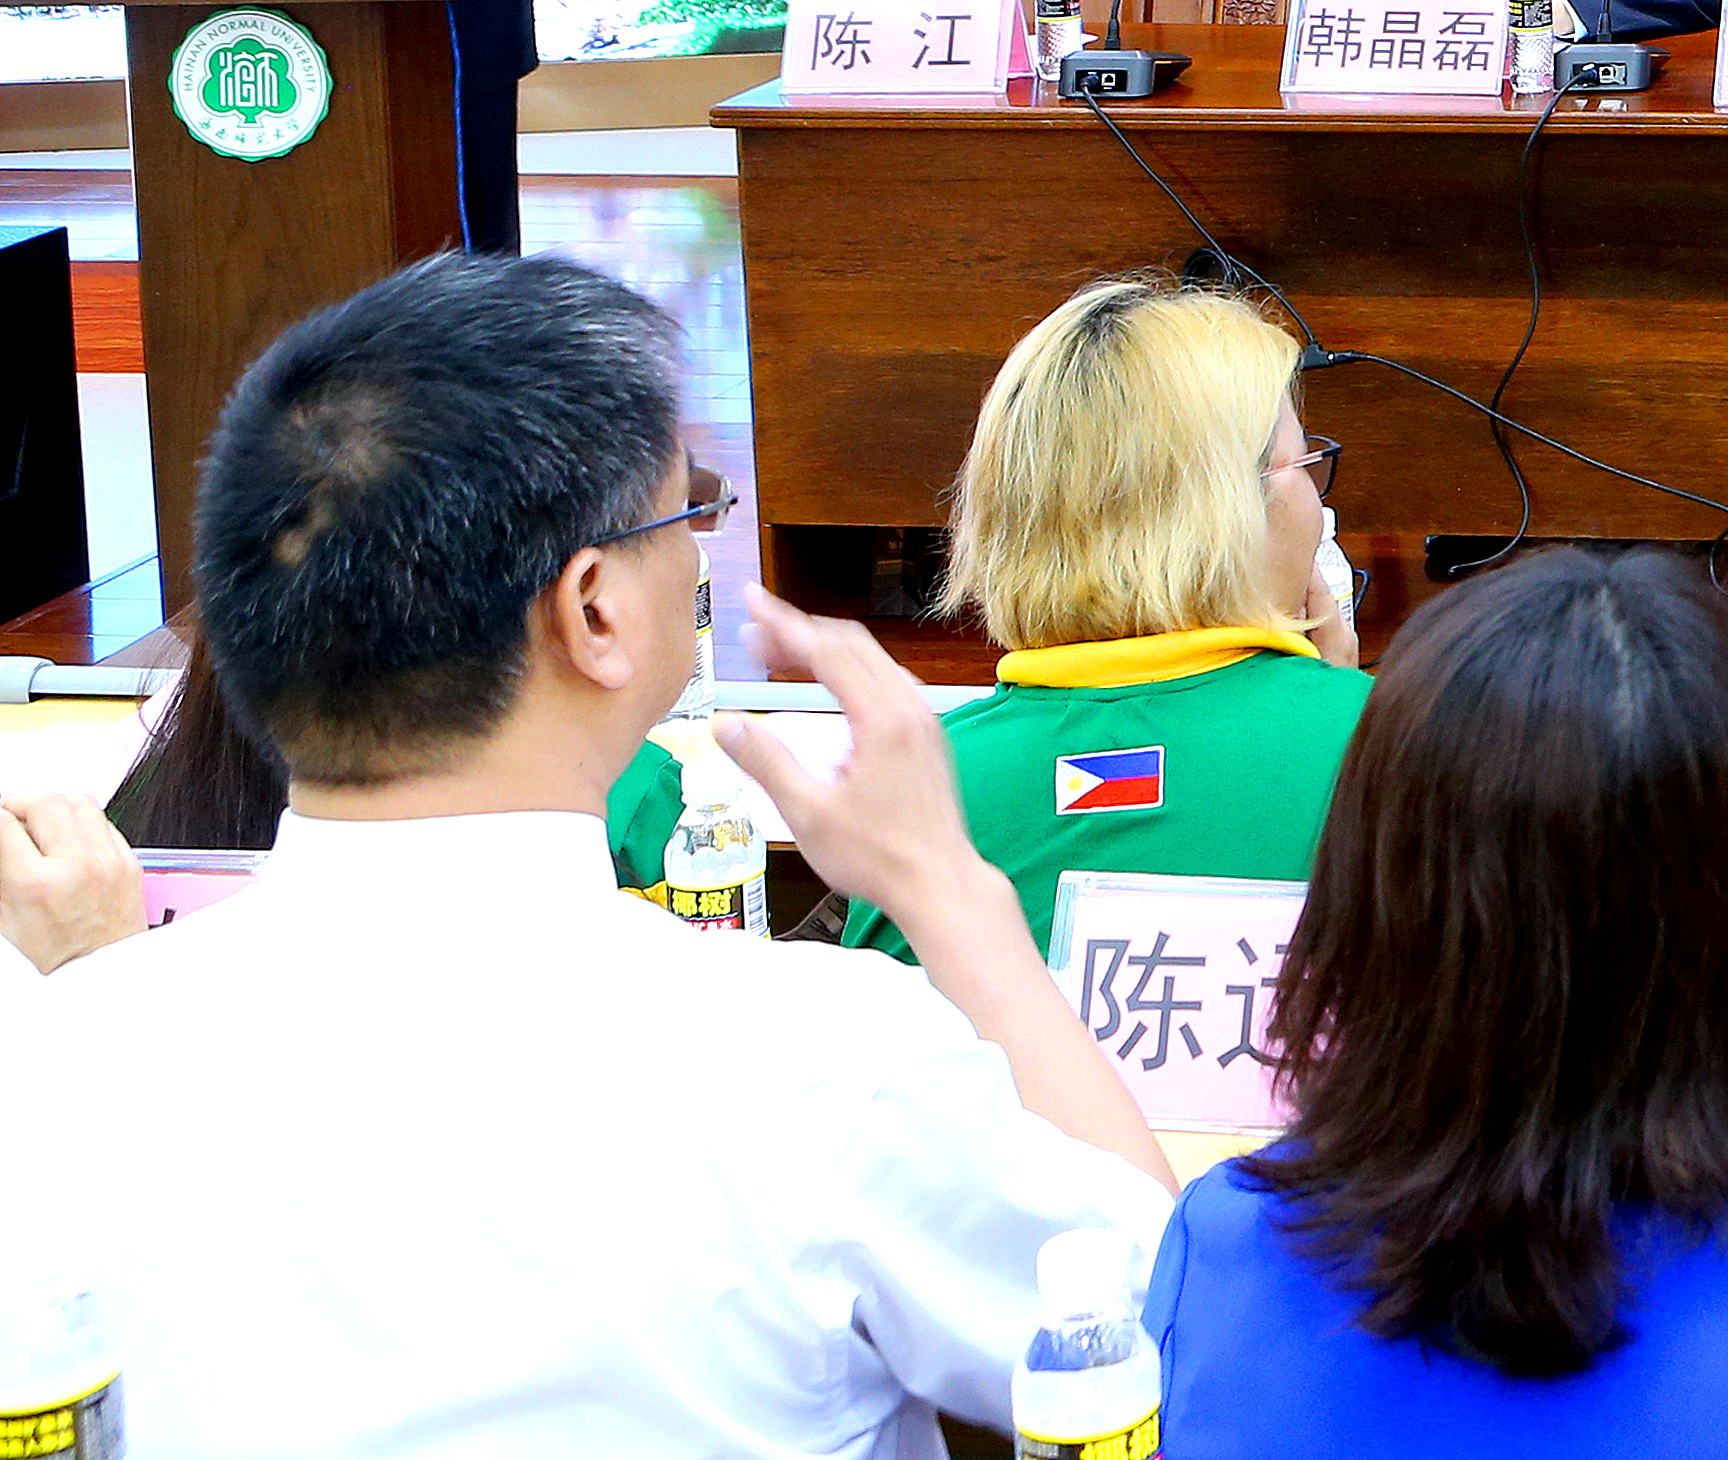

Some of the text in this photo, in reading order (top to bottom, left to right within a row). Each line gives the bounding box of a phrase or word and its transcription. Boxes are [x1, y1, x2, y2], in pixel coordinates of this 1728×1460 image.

[184, 42, 208, 92] HAINAN
[207, 19, 267, 40] NORMAL
[271, 25, 318, 93] UNIVERSITY
[1303, 8, 1494, 71] 韩晶磊
[672, 887, 736, 918] 椰树
